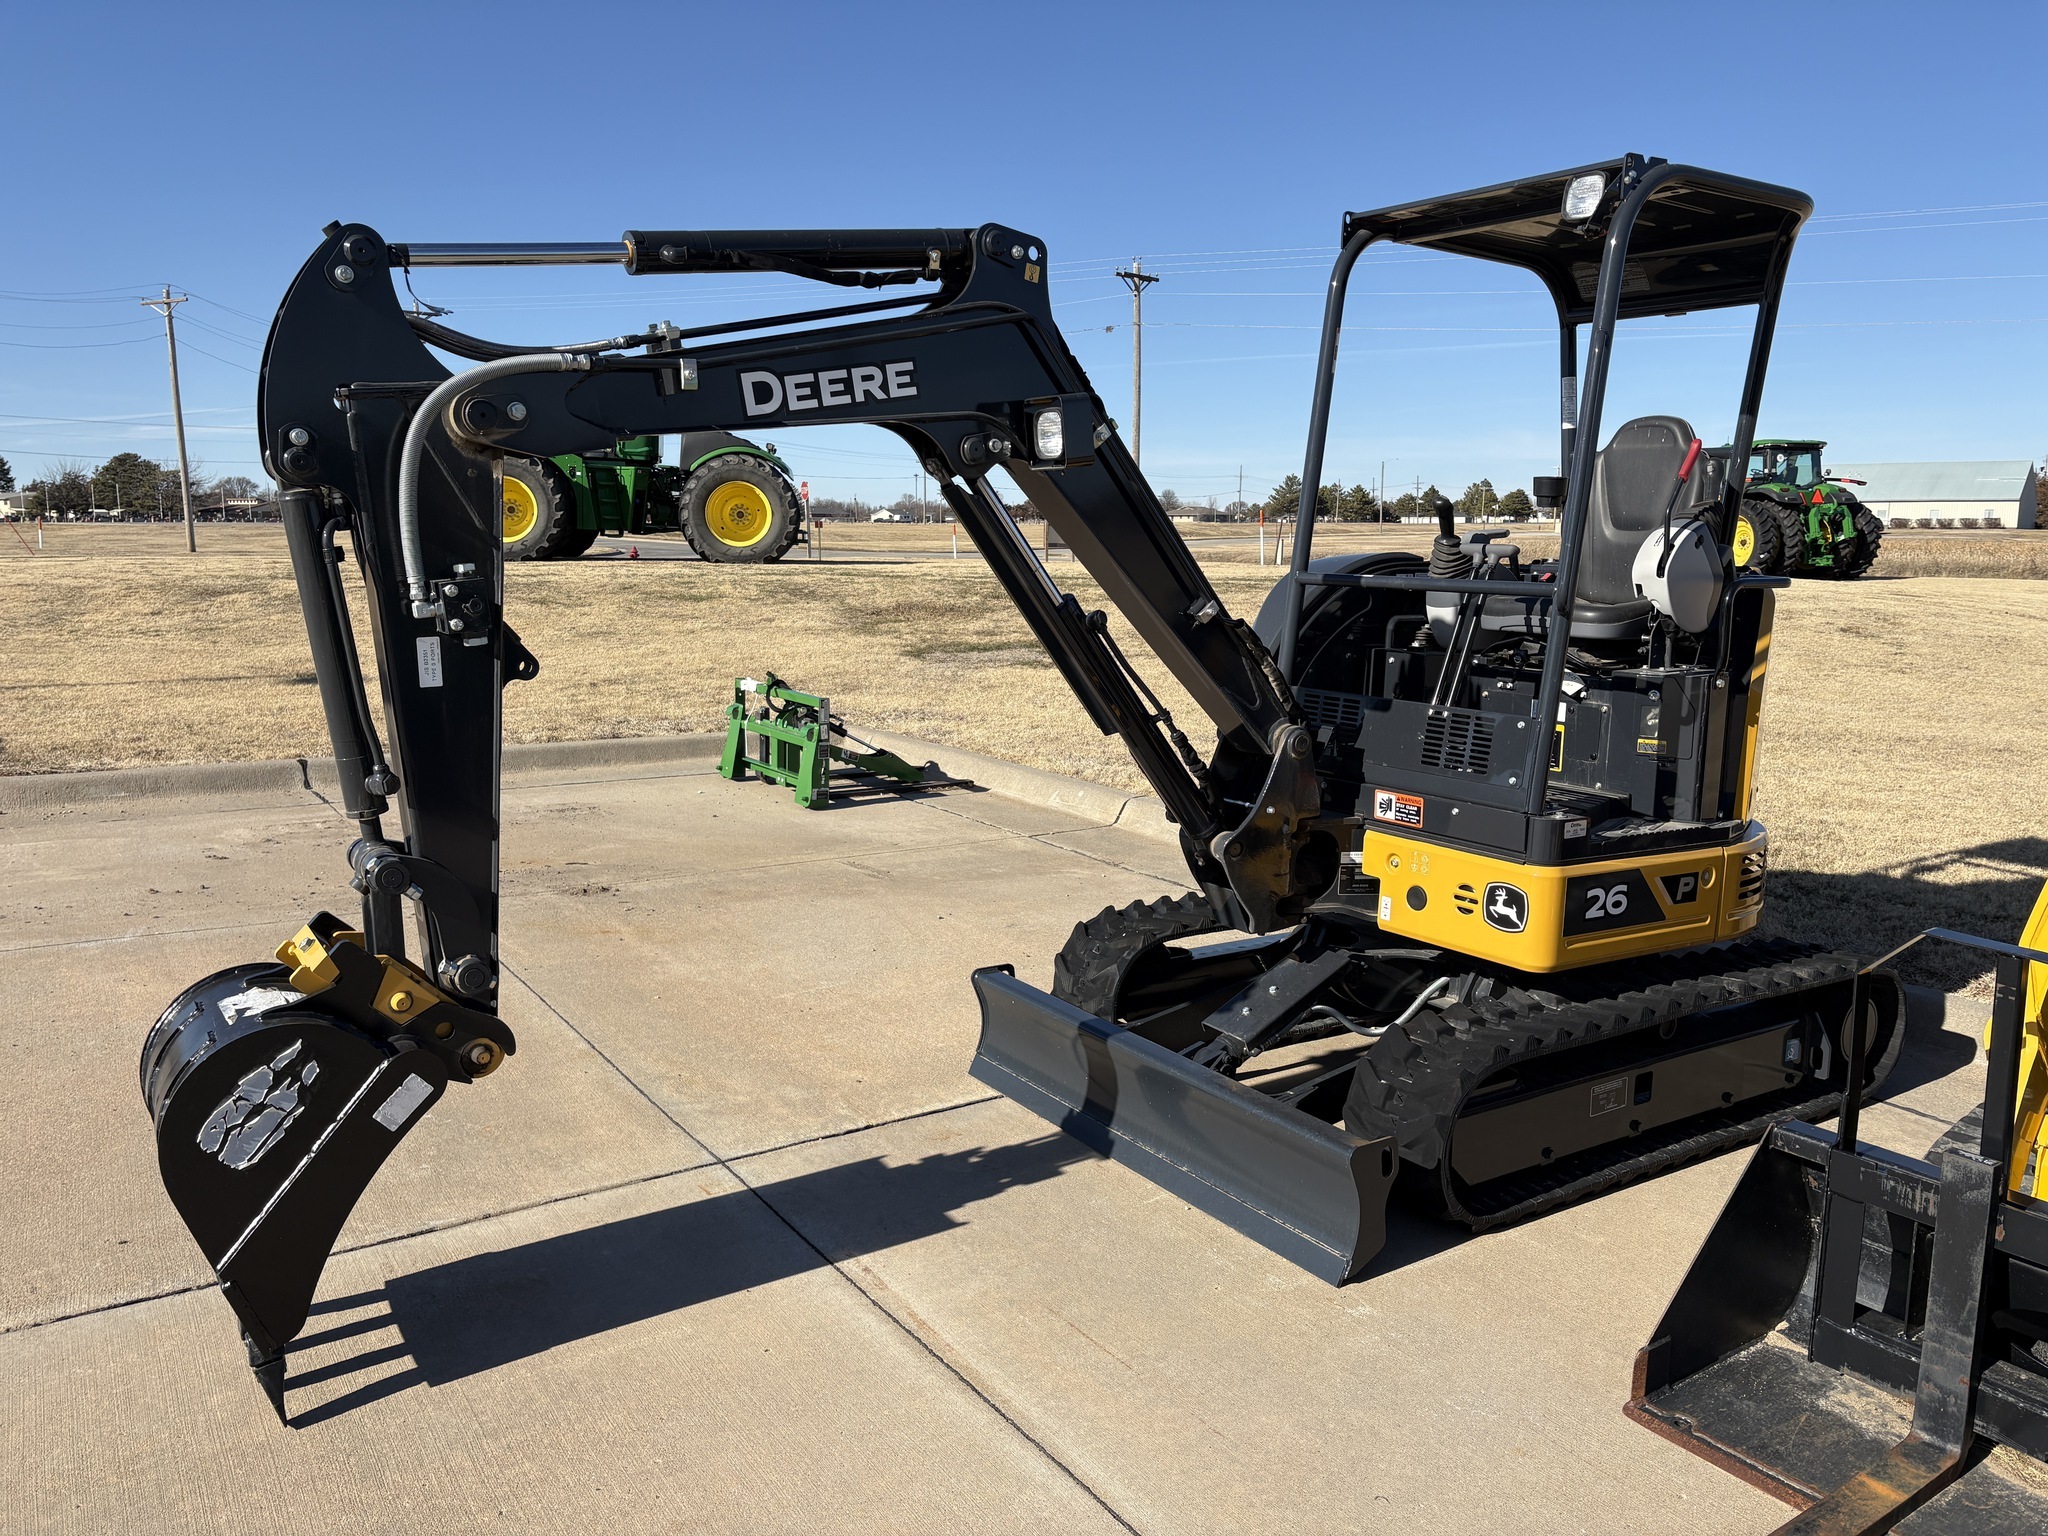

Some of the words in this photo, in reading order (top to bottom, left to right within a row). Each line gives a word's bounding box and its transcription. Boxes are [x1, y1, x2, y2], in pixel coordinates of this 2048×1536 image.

[740, 361, 918, 417] DEERE
[1401, 797, 1422, 805] WARNING
[1584, 884, 1628, 919] 26
[1676, 876, 1695, 901] P
